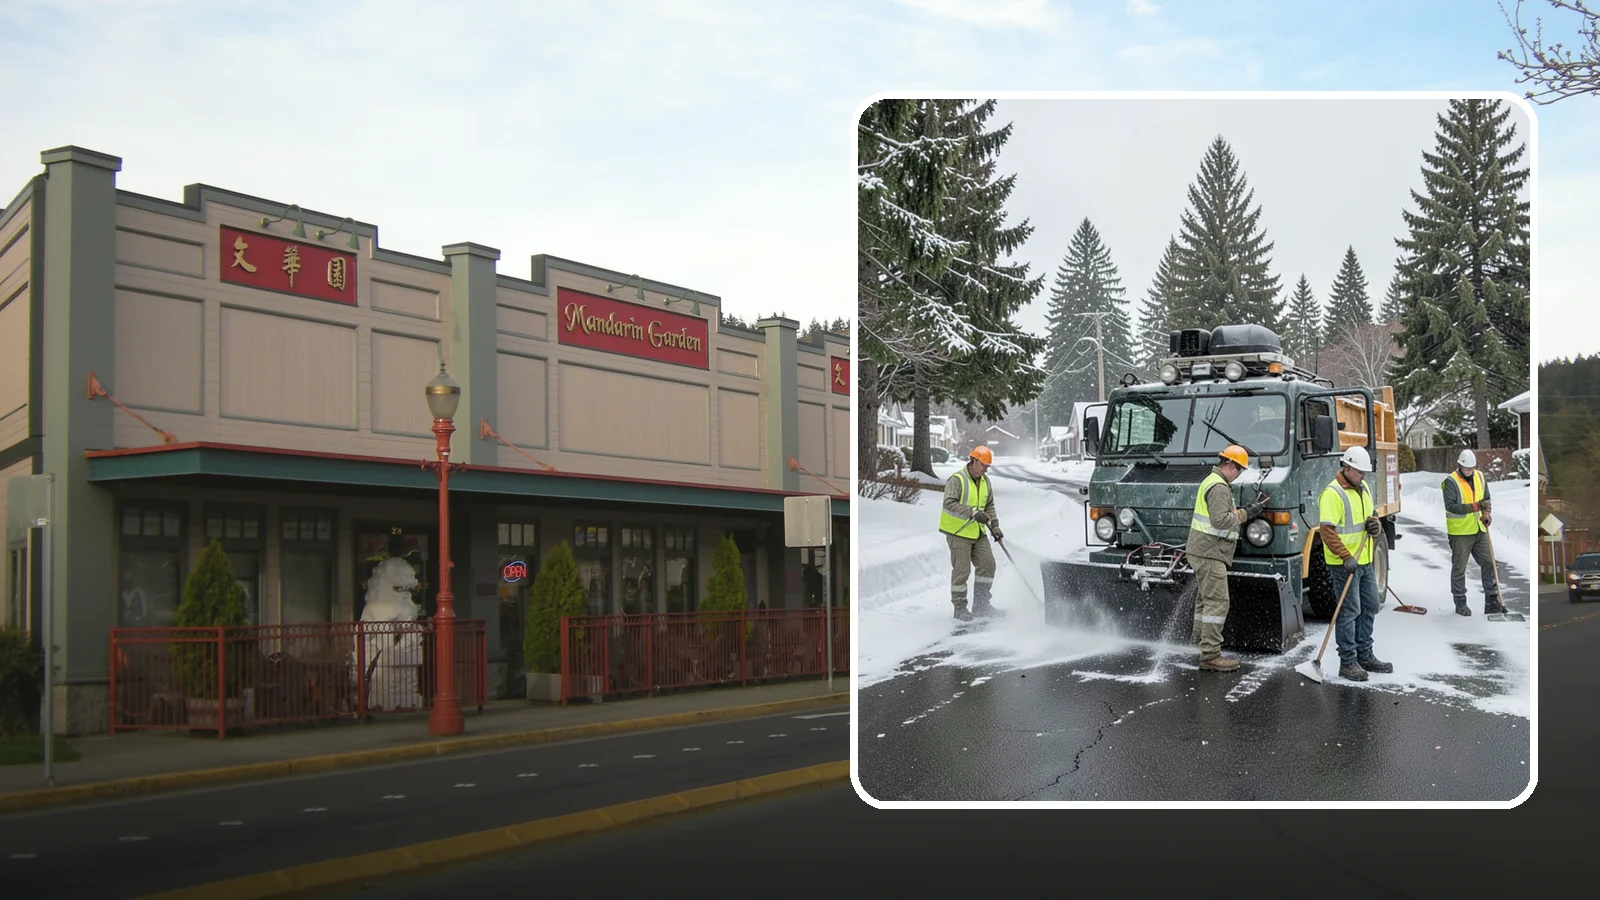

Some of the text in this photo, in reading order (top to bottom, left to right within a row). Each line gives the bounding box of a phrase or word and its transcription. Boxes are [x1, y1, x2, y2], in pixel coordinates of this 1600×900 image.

[230, 236, 346, 291] 文華園
[564, 302, 701, 352] Mandarin Garden
[835, 363, 846, 386] 文
[503, 565, 527, 578] OPEN
